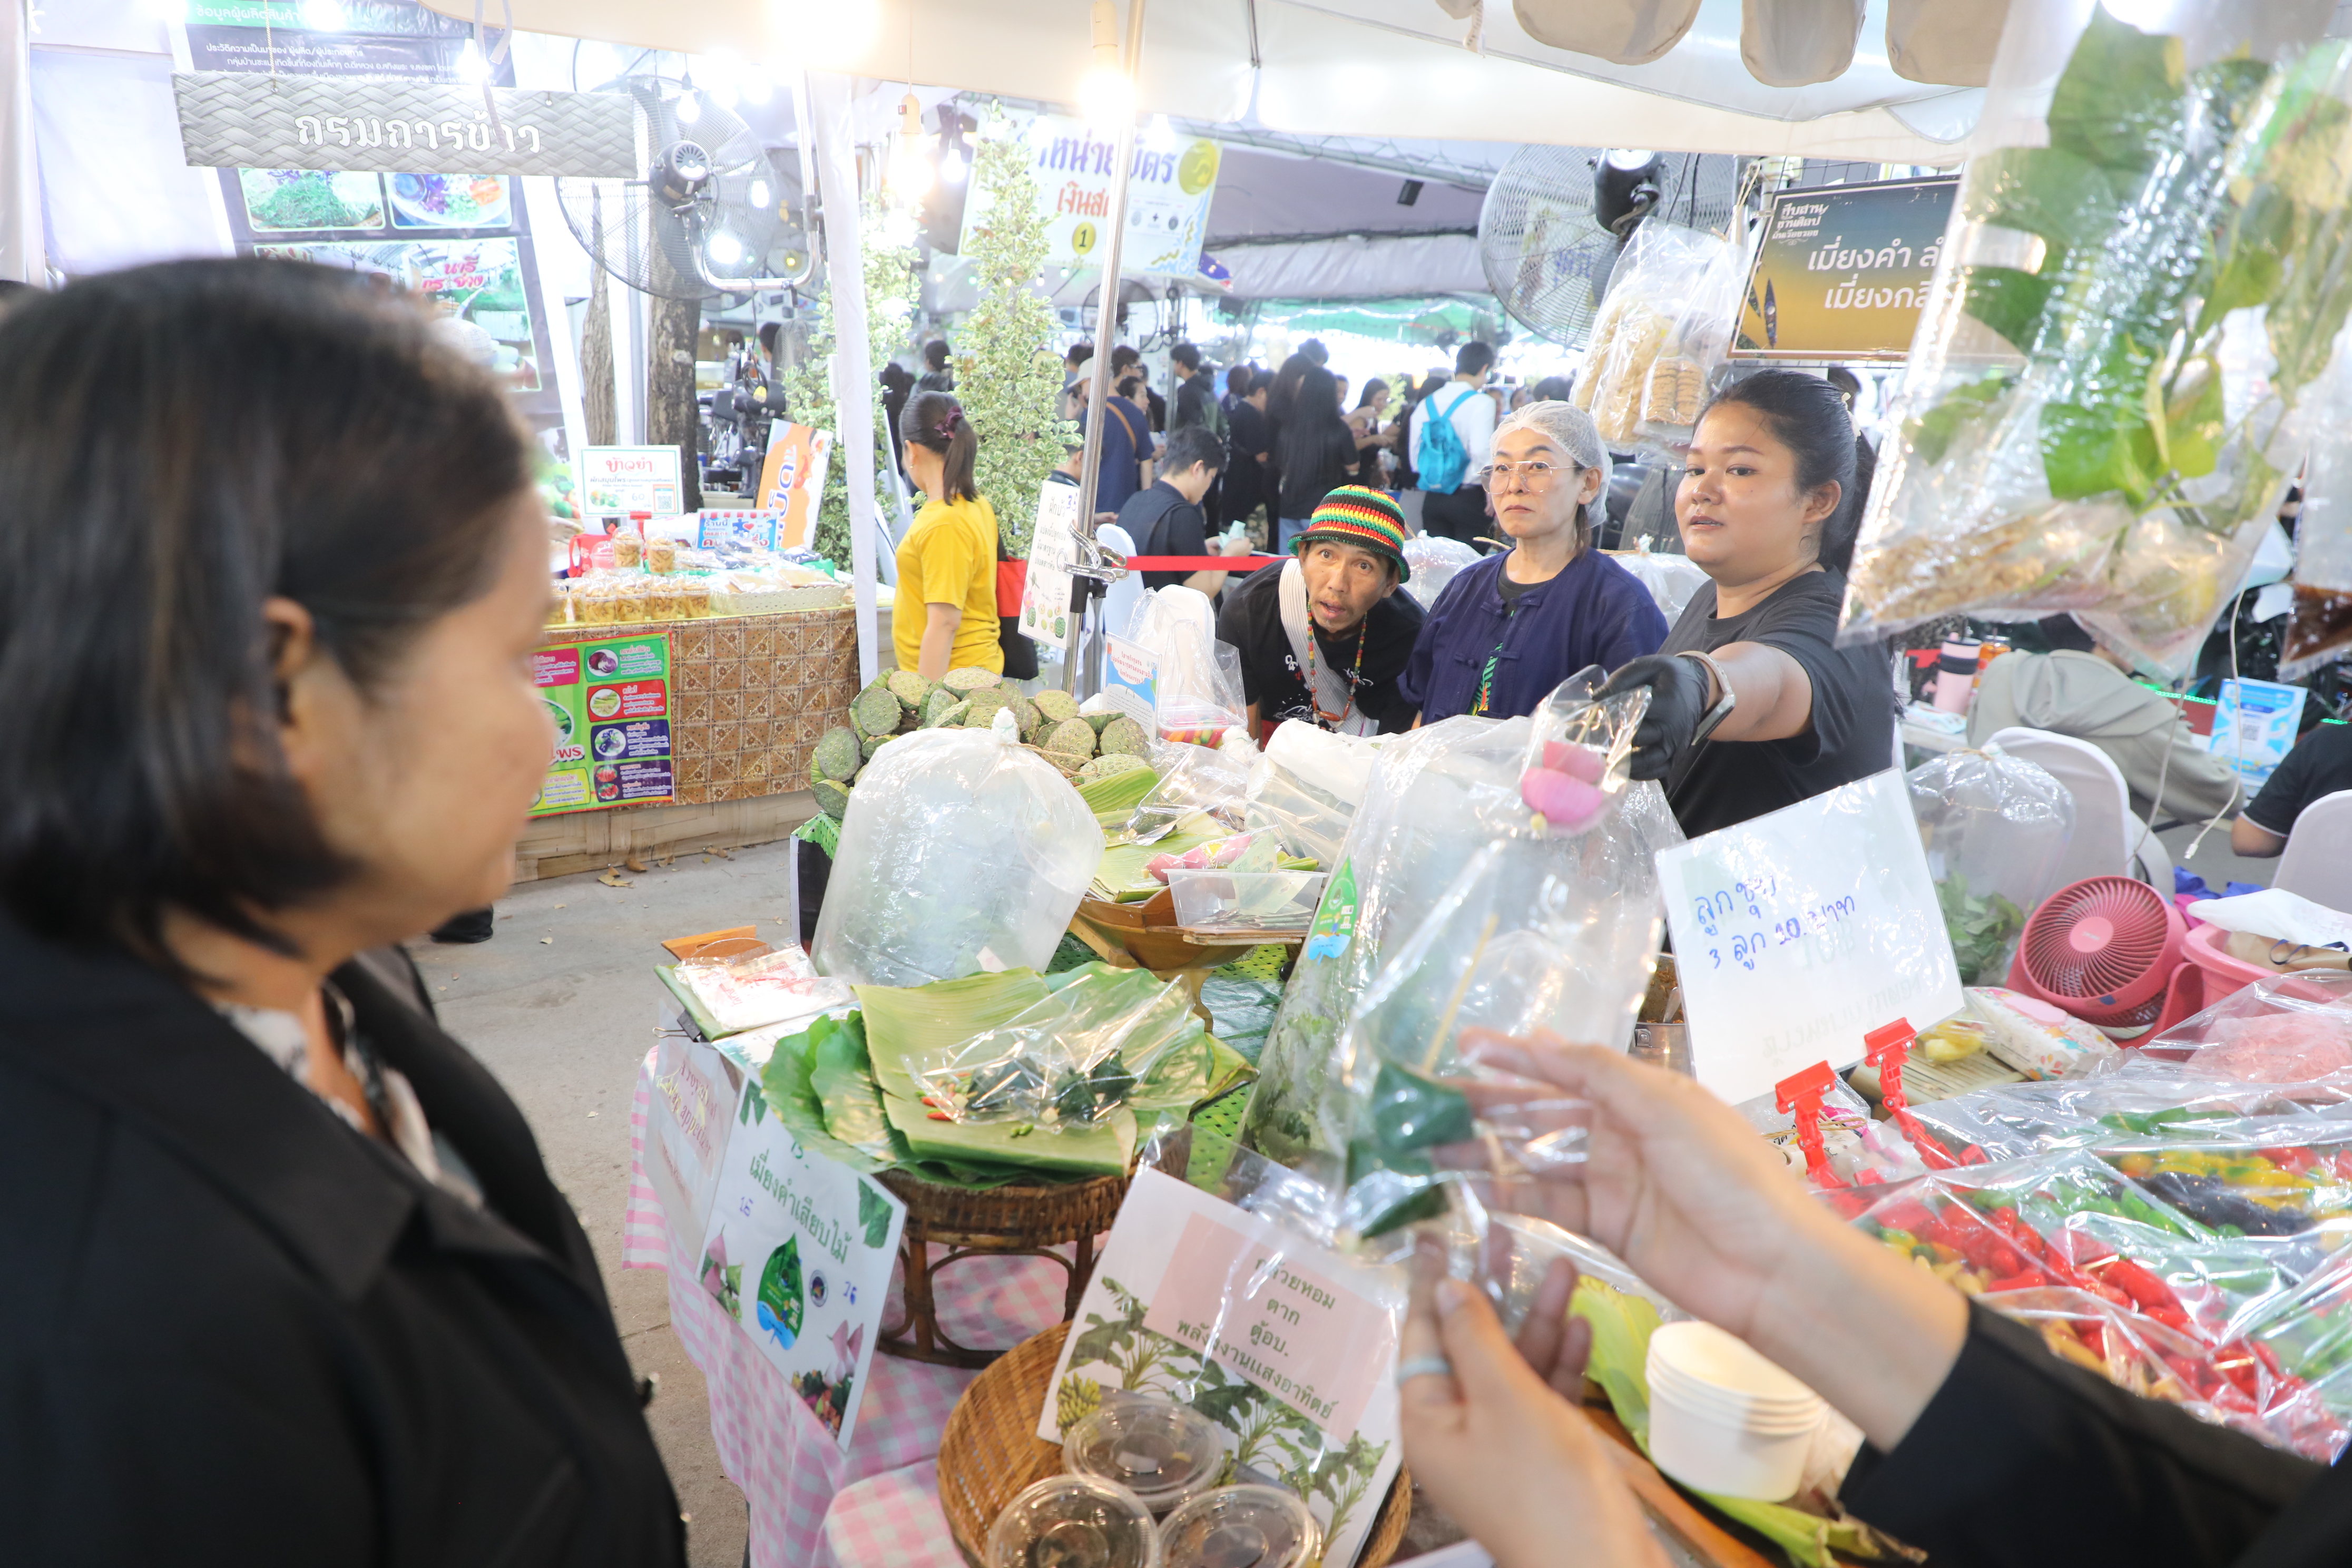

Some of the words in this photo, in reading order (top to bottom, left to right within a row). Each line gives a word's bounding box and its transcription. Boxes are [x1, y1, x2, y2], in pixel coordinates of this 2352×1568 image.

[196, 4, 300, 22] ข้อมูลผู้ผลิตสินค้า
[295, 111, 542, 154] กรมการข้าว
[1808, 236, 1912, 271] เมี่ยงคำ
[606, 456, 653, 473] ข้าวยำ
[632, 492, 645, 502] 60
[1048, 496, 1066, 517] ฝักบัว
[1709, 948, 1721, 969] 3
[1731, 932, 1766, 971] ลูก
[750, 1149, 853, 1265] เมี่ยงคำเสียบไม้
[1267, 1296, 1301, 1326] ตาก
